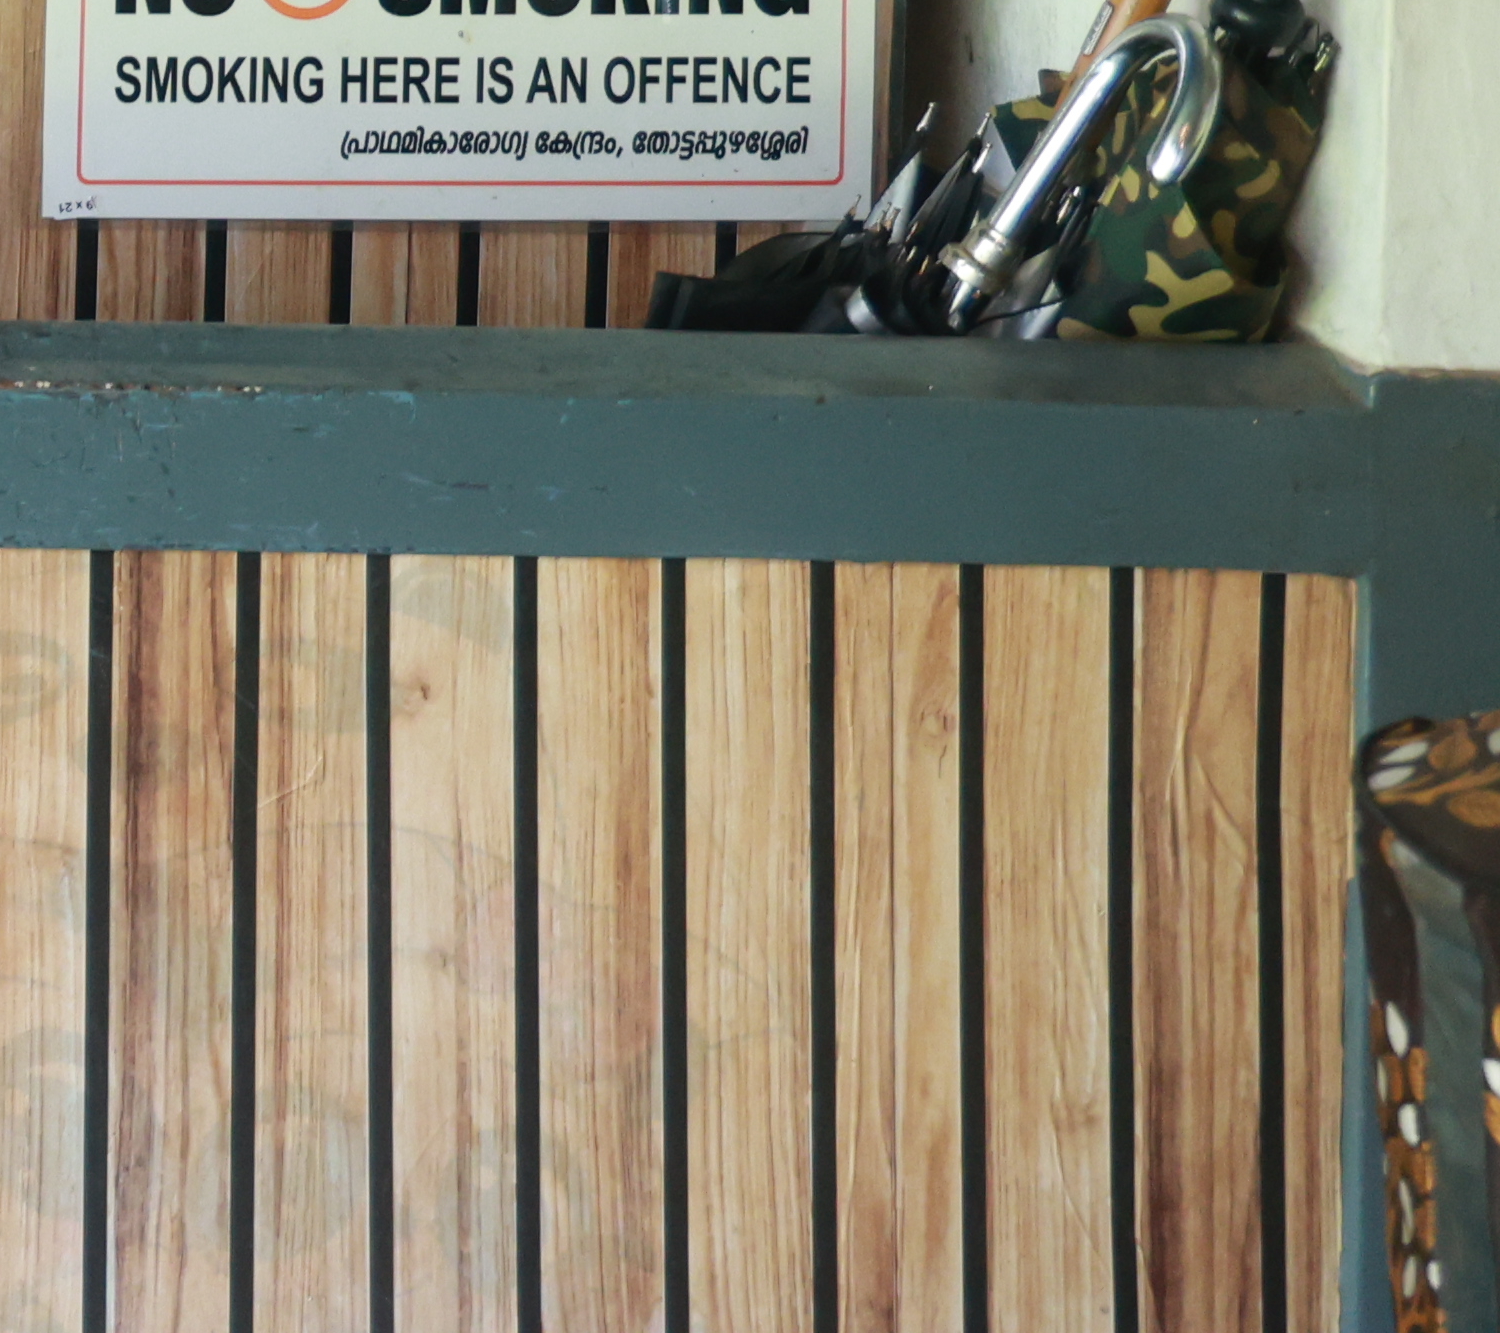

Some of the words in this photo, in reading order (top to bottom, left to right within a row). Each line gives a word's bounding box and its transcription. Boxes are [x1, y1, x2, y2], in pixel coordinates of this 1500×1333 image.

[114, 56, 325, 105] SMOKING
[341, 56, 461, 104] HERE
[477, 56, 515, 106] IS
[526, 57, 589, 105] AN
[604, 56, 812, 106] OFFENCE
[340, 125, 530, 161] പ്രാഥമികാരോഗ്യ
